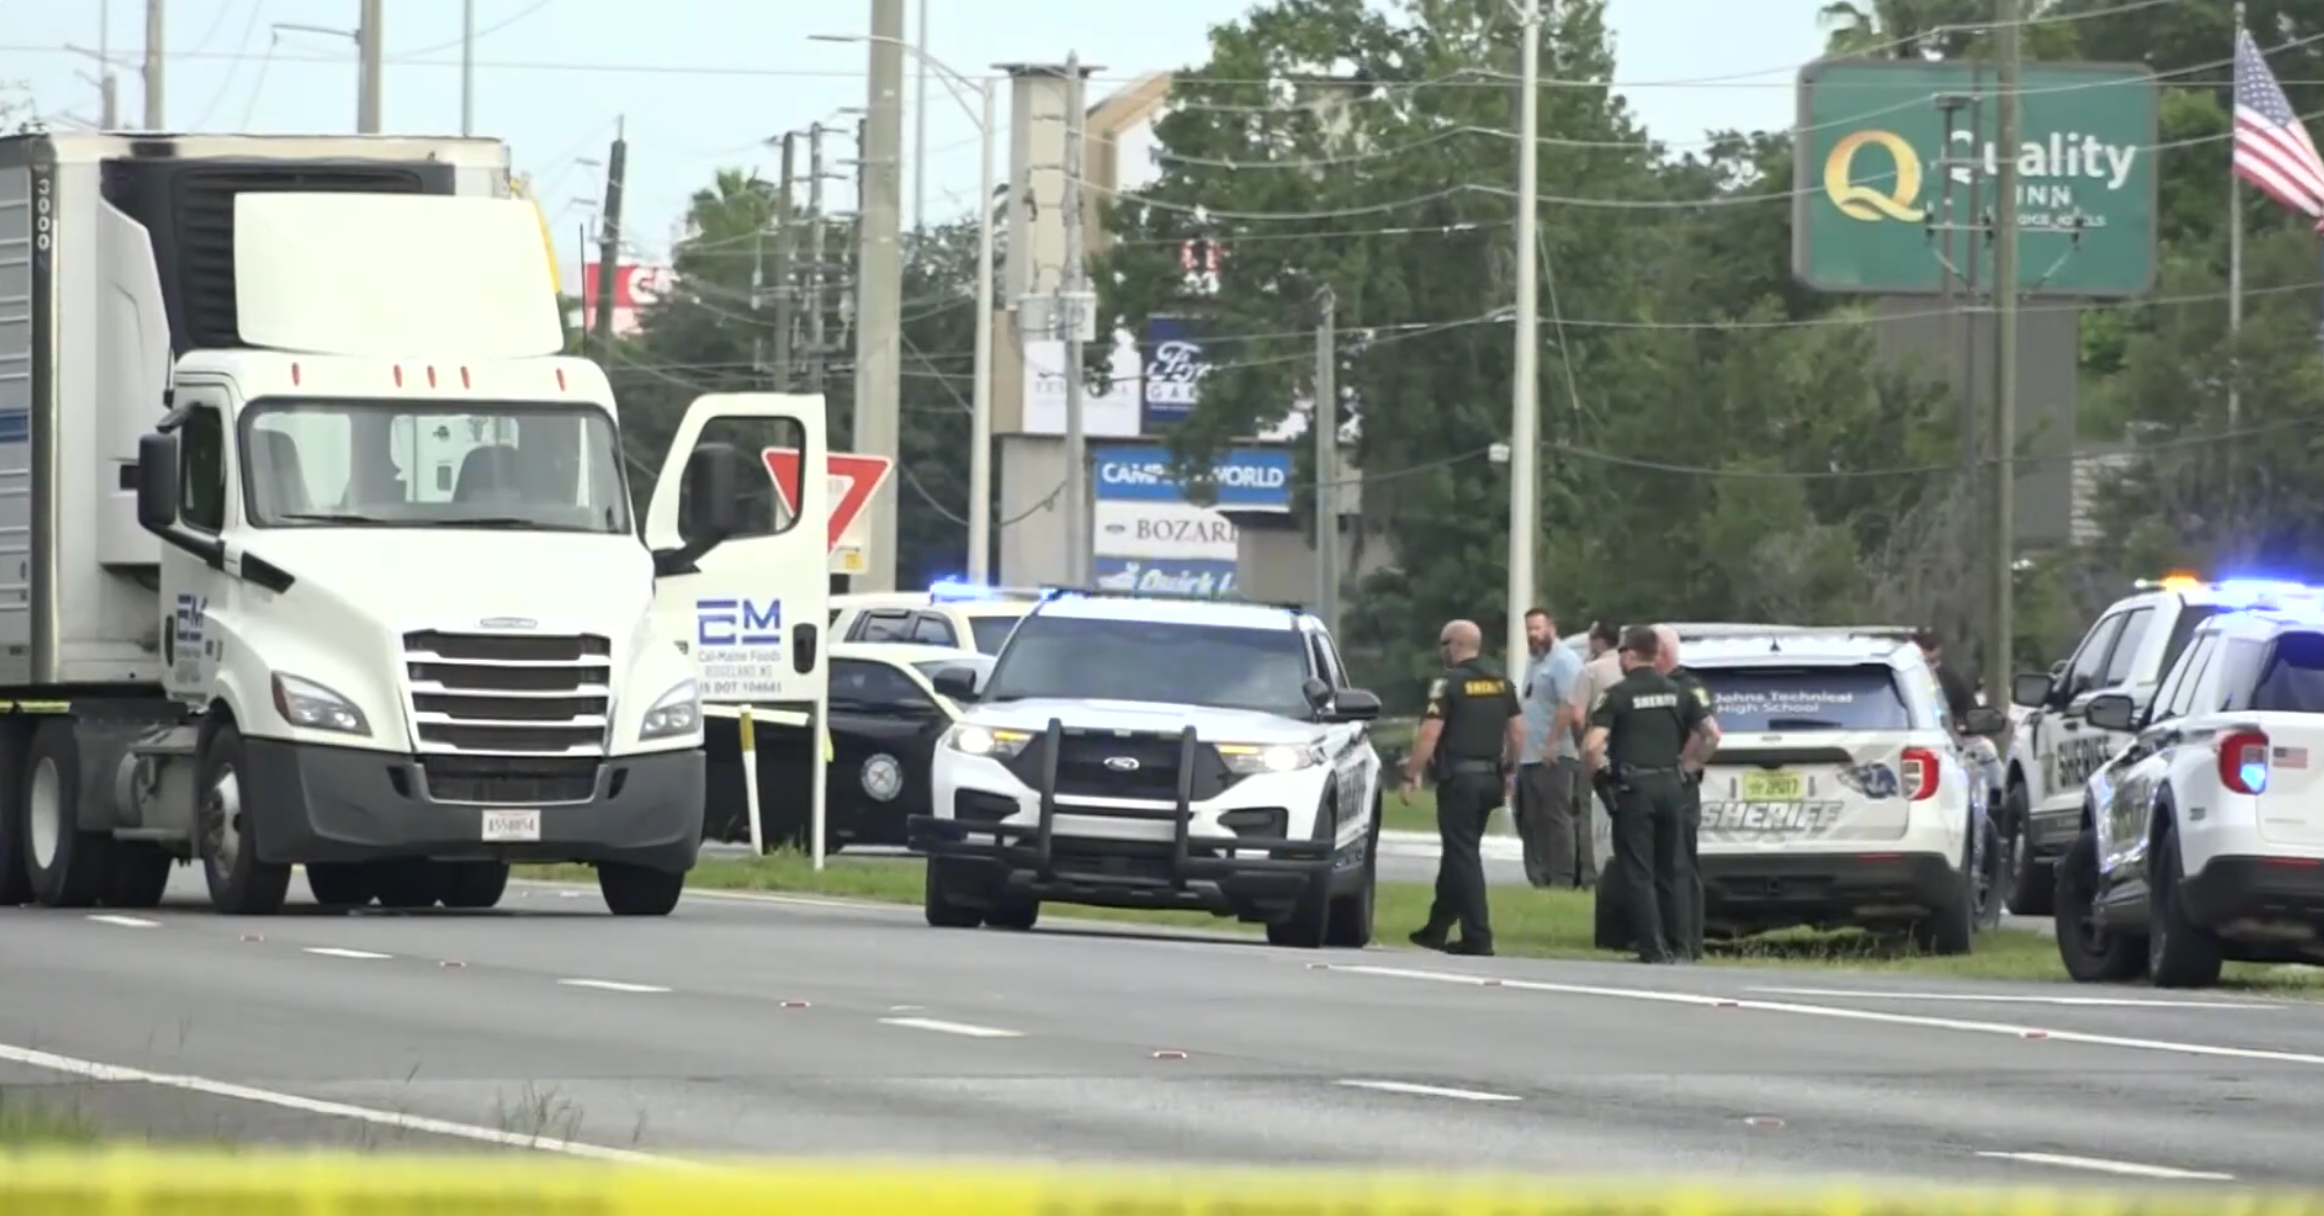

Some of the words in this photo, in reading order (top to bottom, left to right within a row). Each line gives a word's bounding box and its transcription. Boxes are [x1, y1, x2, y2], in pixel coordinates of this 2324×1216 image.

[1823, 130, 1926, 222] Q
[2016, 185, 2072, 208] INN
[37, 178, 51, 252] 3000
[1715, 703, 1758, 715] High
[1762, 702, 1821, 713] School
[1770, 691, 1854, 704] Technical
[1700, 799, 1845, 832] SHERIFF
